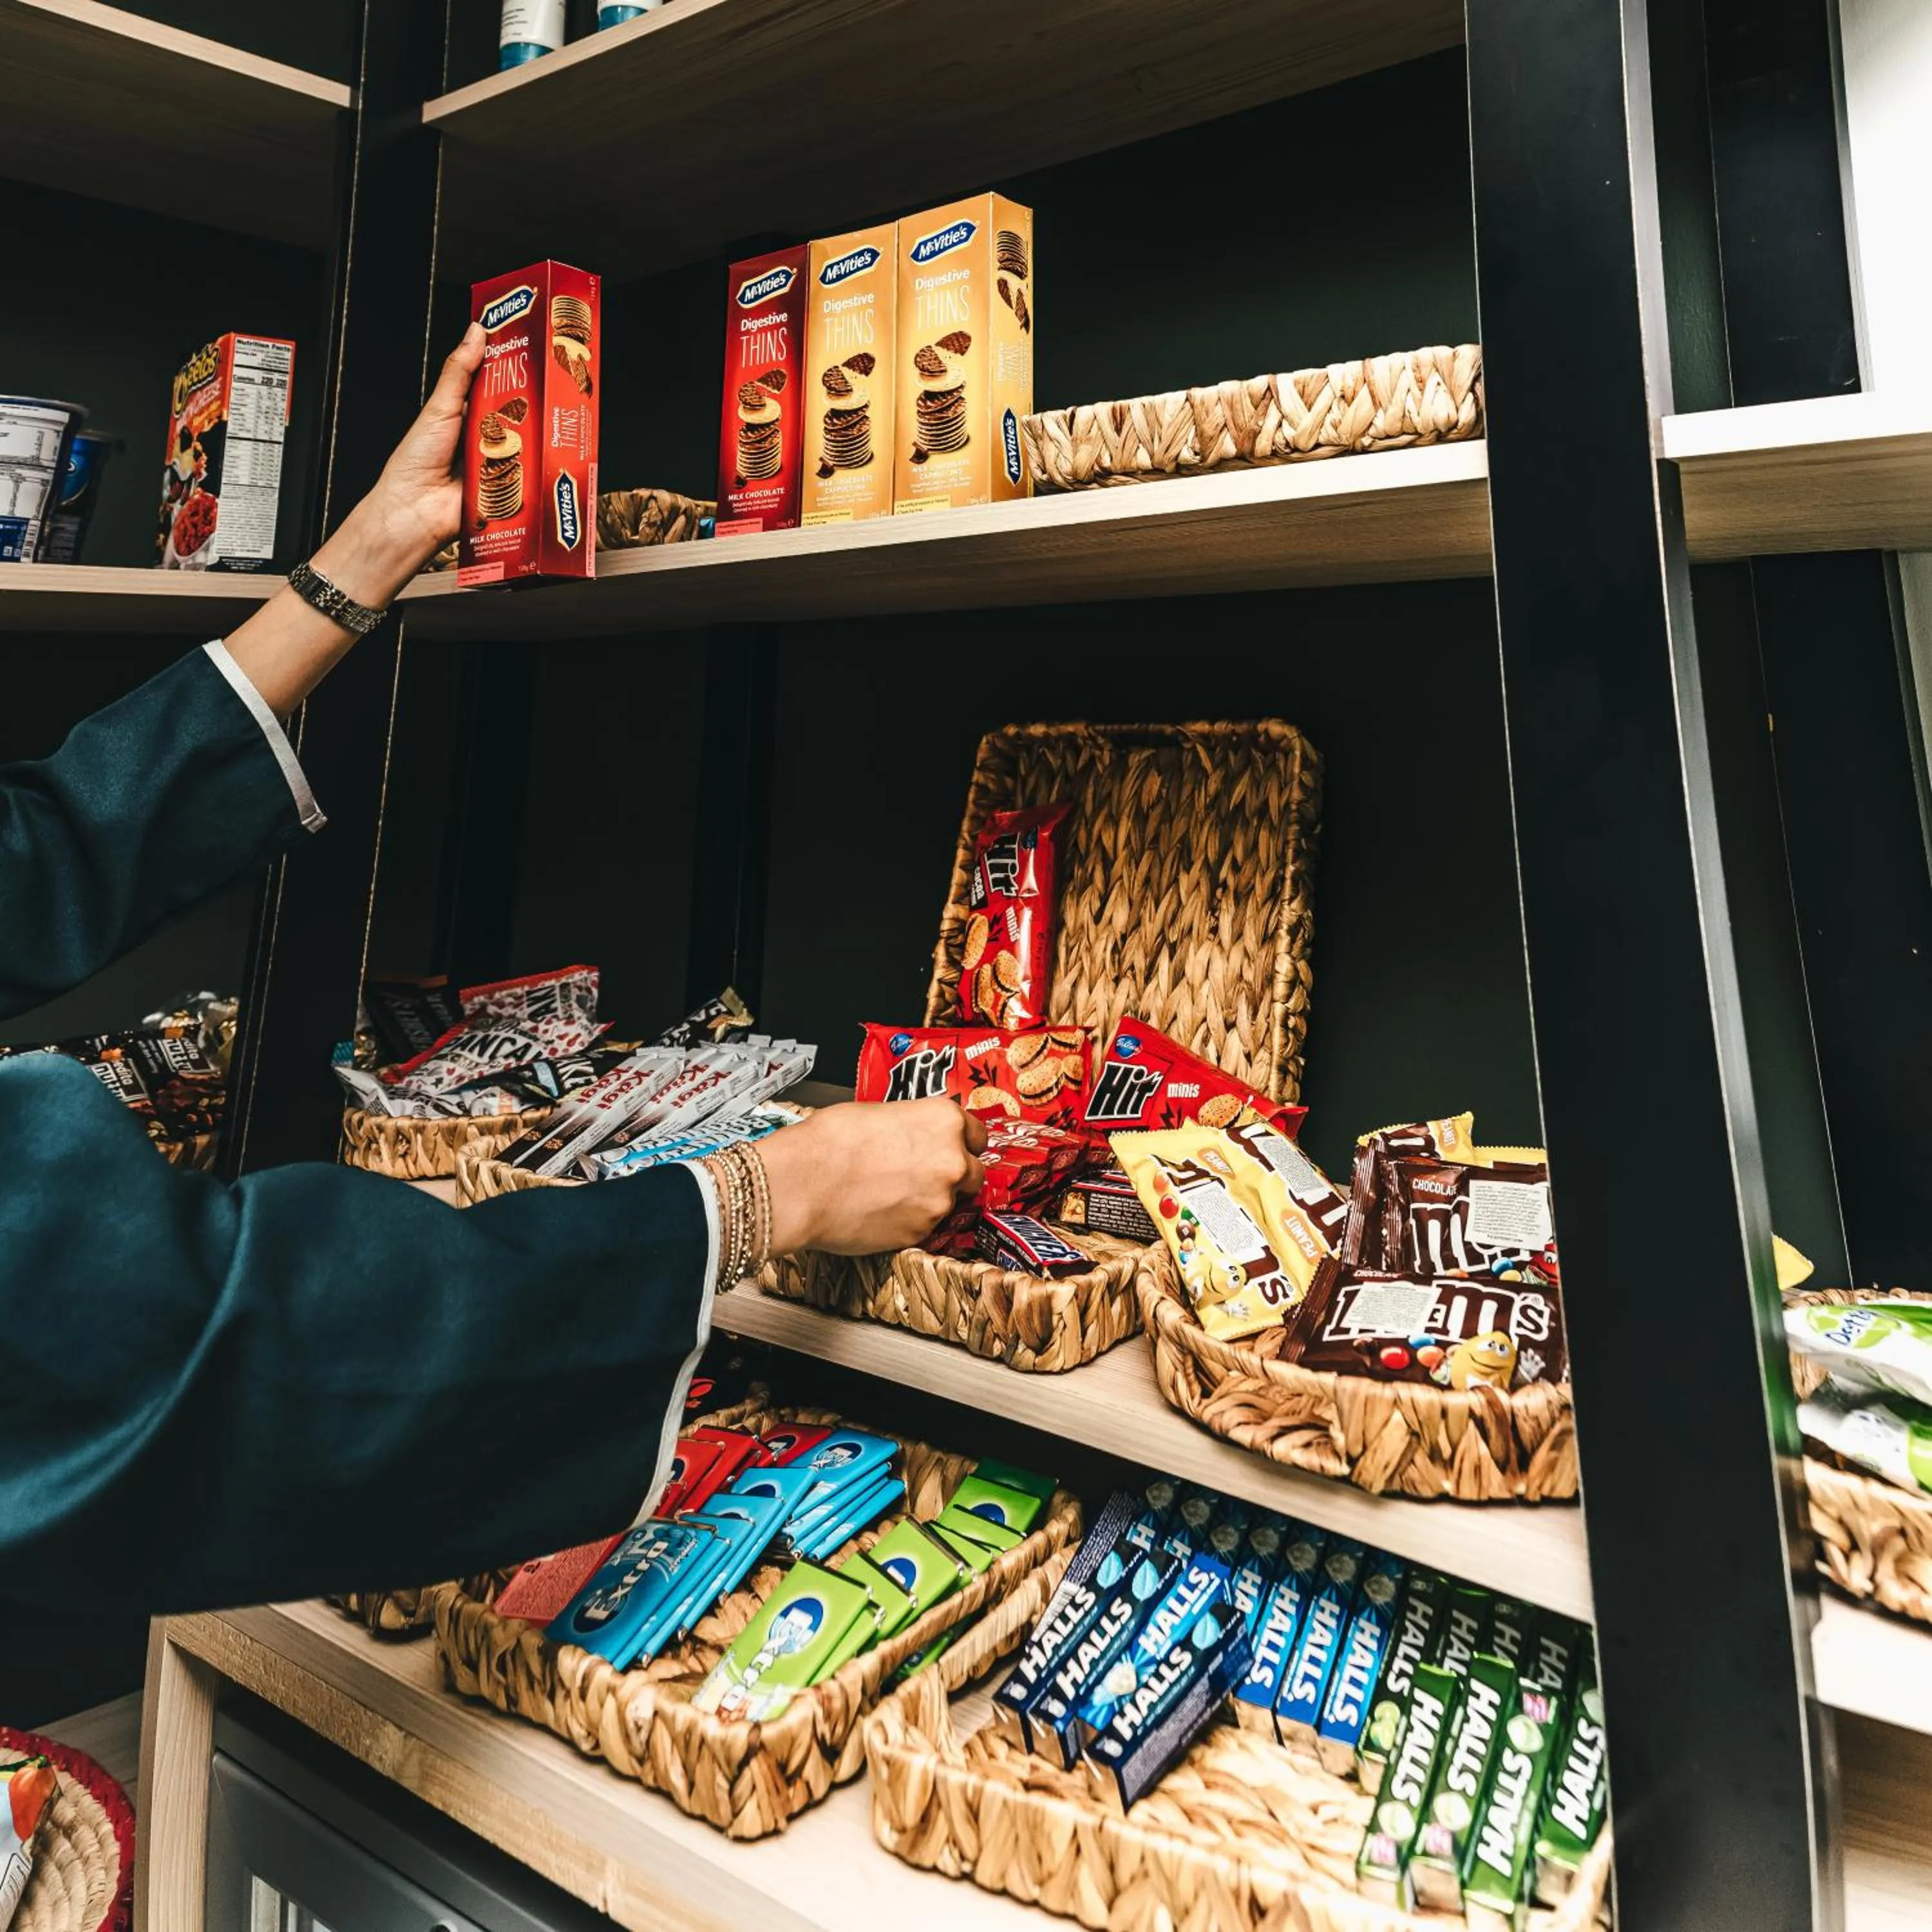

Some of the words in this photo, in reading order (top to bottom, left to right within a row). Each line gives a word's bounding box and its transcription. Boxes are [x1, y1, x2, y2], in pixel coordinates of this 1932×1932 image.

[915, 269, 970, 290] Digestive
[741, 312, 788, 332] Digestive
[824, 293, 875, 313] Digestive
[915, 285, 970, 330] THINS
[484, 335, 529, 359] Digestive
[740, 327, 788, 370] THINS
[824, 309, 875, 351] THINS
[484, 352, 528, 398] THINS
[560, 408, 578, 448] THINS
[728, 492, 744, 502] MILK
[745, 487, 784, 500] CHOCOLATE
[469, 535, 485, 545] MILK
[486, 527, 526, 542] CHOCOLATE
[1005, 905, 1021, 942] minis
[965, 1036, 1001, 1061] minis
[1166, 1083, 1201, 1098] minis
[1286, 1217, 1318, 1259] PEANUT
[1019, 1586, 1097, 1684] HALLS
[1137, 1565, 1212, 1660] HALLS
[1055, 1596, 1133, 1701] HALLS
[1250, 1584, 1301, 1690] HALLS
[1291, 1596, 1341, 1705] HALLS
[1387, 1596, 1434, 1697] HALLS
[1442, 1609, 1479, 1676] HAL
[1112, 1645, 1193, 1741] HALLS
[1332, 1616, 1381, 1727] HALLS
[1390, 1687, 1444, 1808] HALLS
[1446, 1678, 1501, 1797] HALLS
[1551, 1717, 1606, 1842] HALLS
[1476, 1747, 1533, 1877] HALLS
